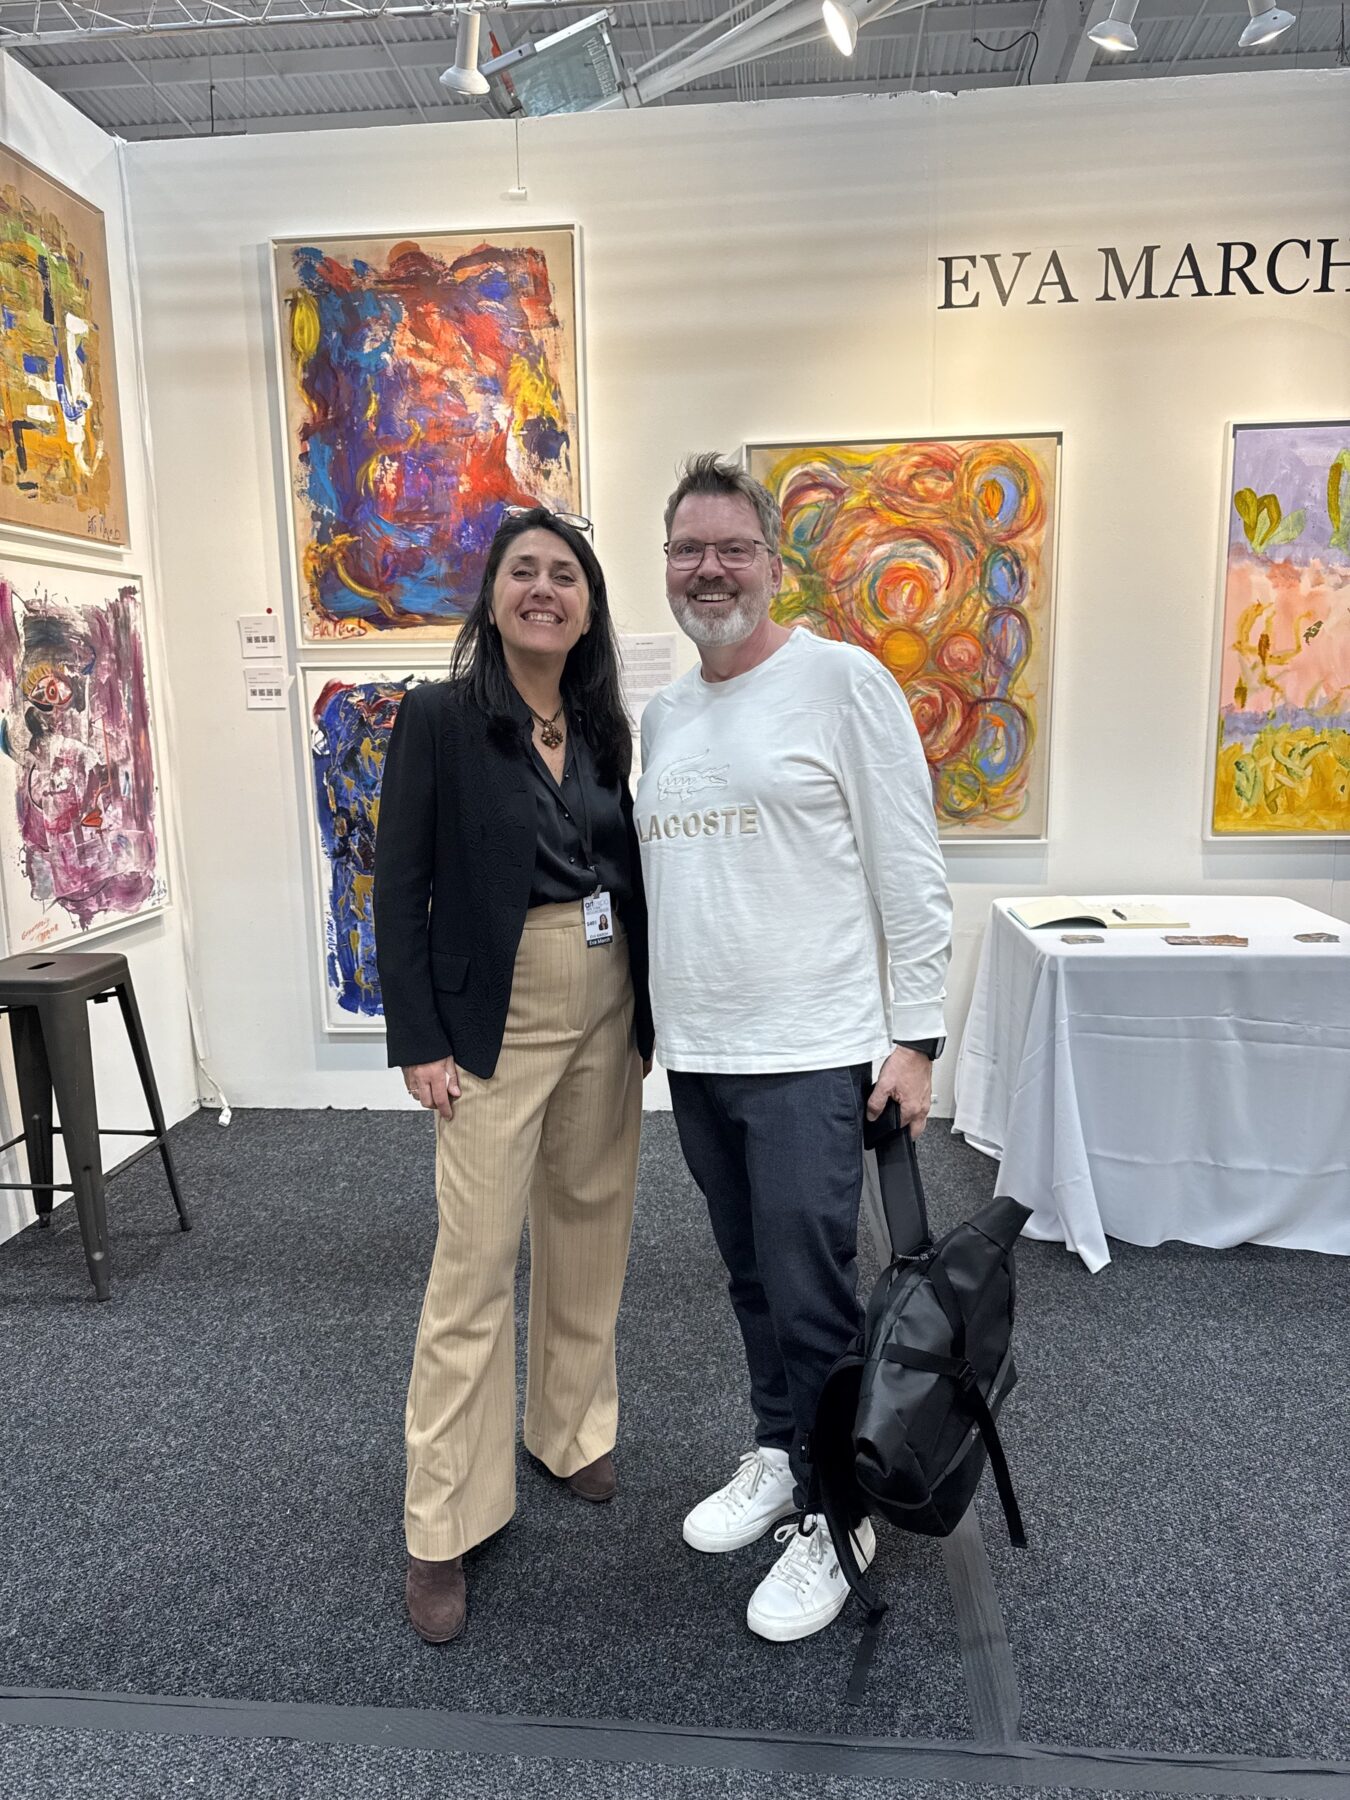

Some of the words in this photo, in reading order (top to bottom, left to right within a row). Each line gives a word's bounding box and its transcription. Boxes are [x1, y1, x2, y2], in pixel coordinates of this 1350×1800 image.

[937, 249, 1079, 310] EVA
[1095, 238, 1350, 301] MARCH
[636, 804, 758, 843] LACOSTE
